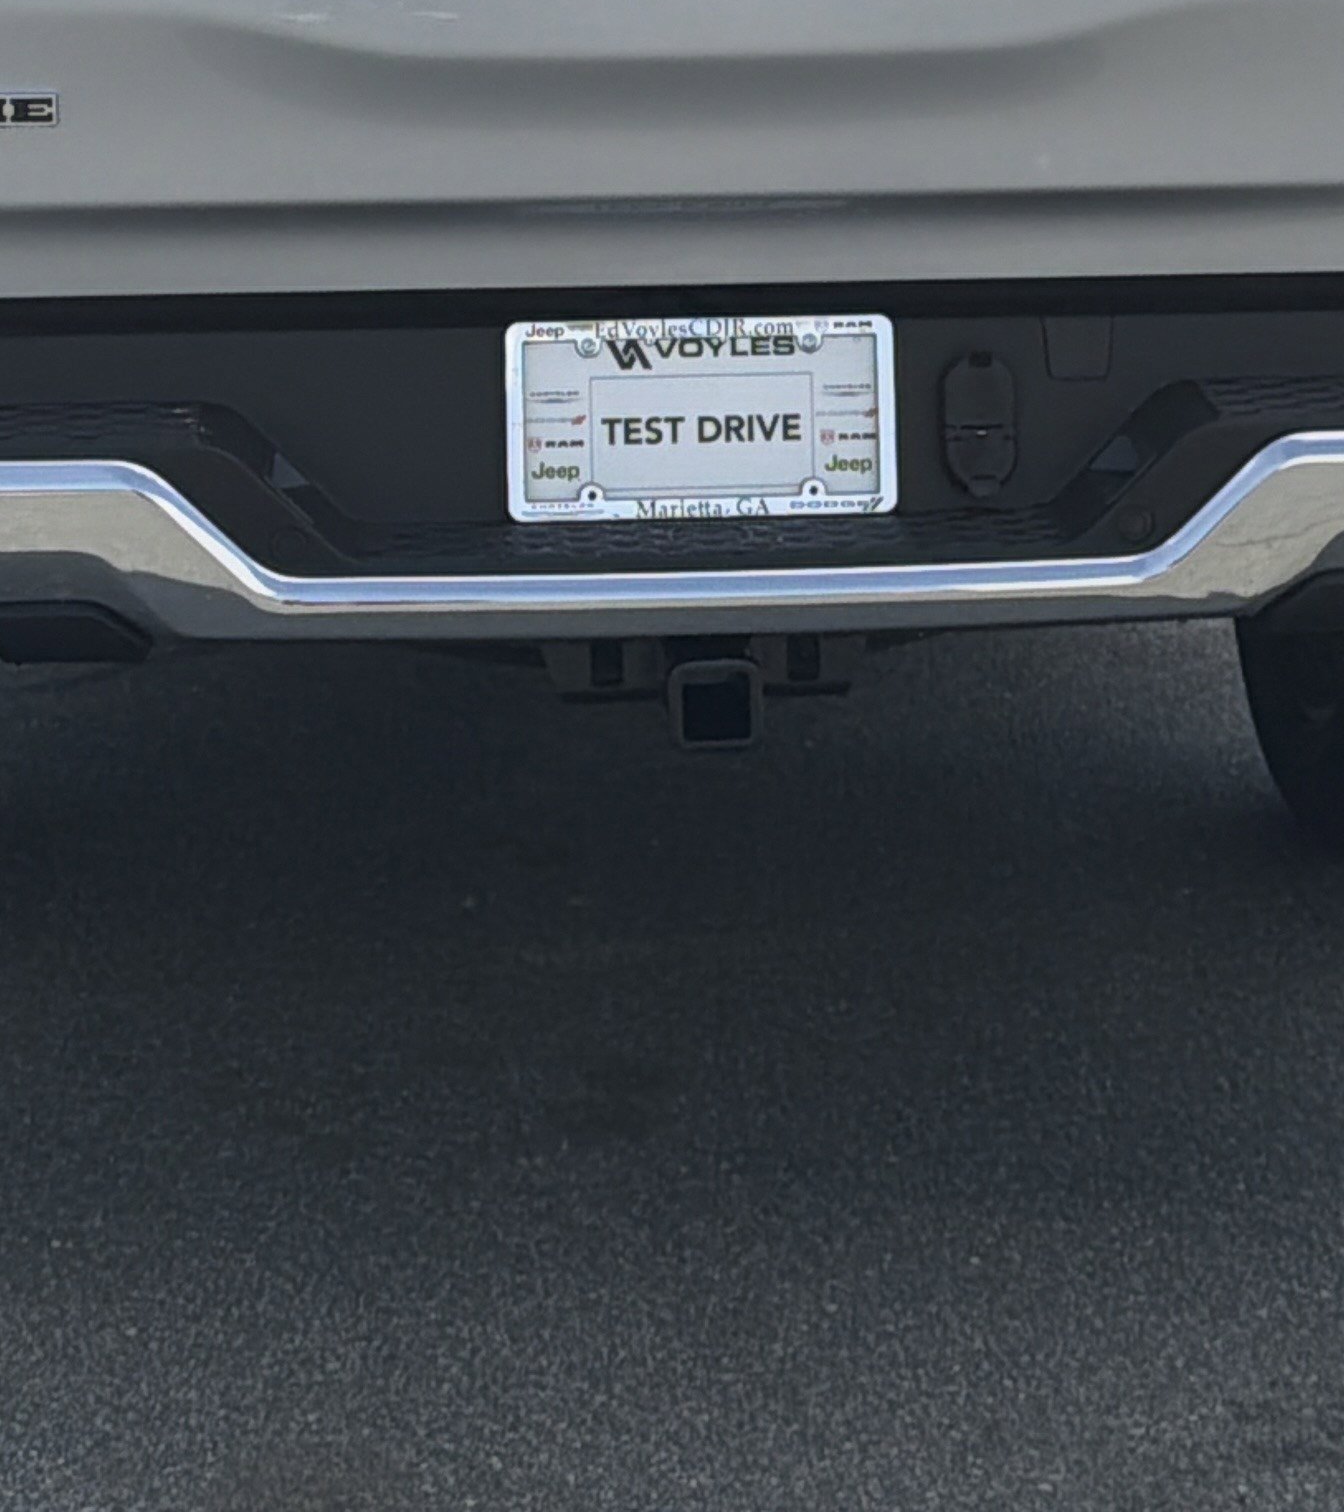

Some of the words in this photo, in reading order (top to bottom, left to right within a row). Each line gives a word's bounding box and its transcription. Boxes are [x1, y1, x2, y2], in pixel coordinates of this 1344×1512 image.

[525, 323, 565, 339] Jeep
[656, 334, 796, 359] VOYLES
[601, 416, 686, 446] TEST
[697, 413, 802, 444] DRIVE
[531, 461, 581, 482] Jeep
[824, 454, 873, 474] Jeep
[736, 496, 770, 516] GA
